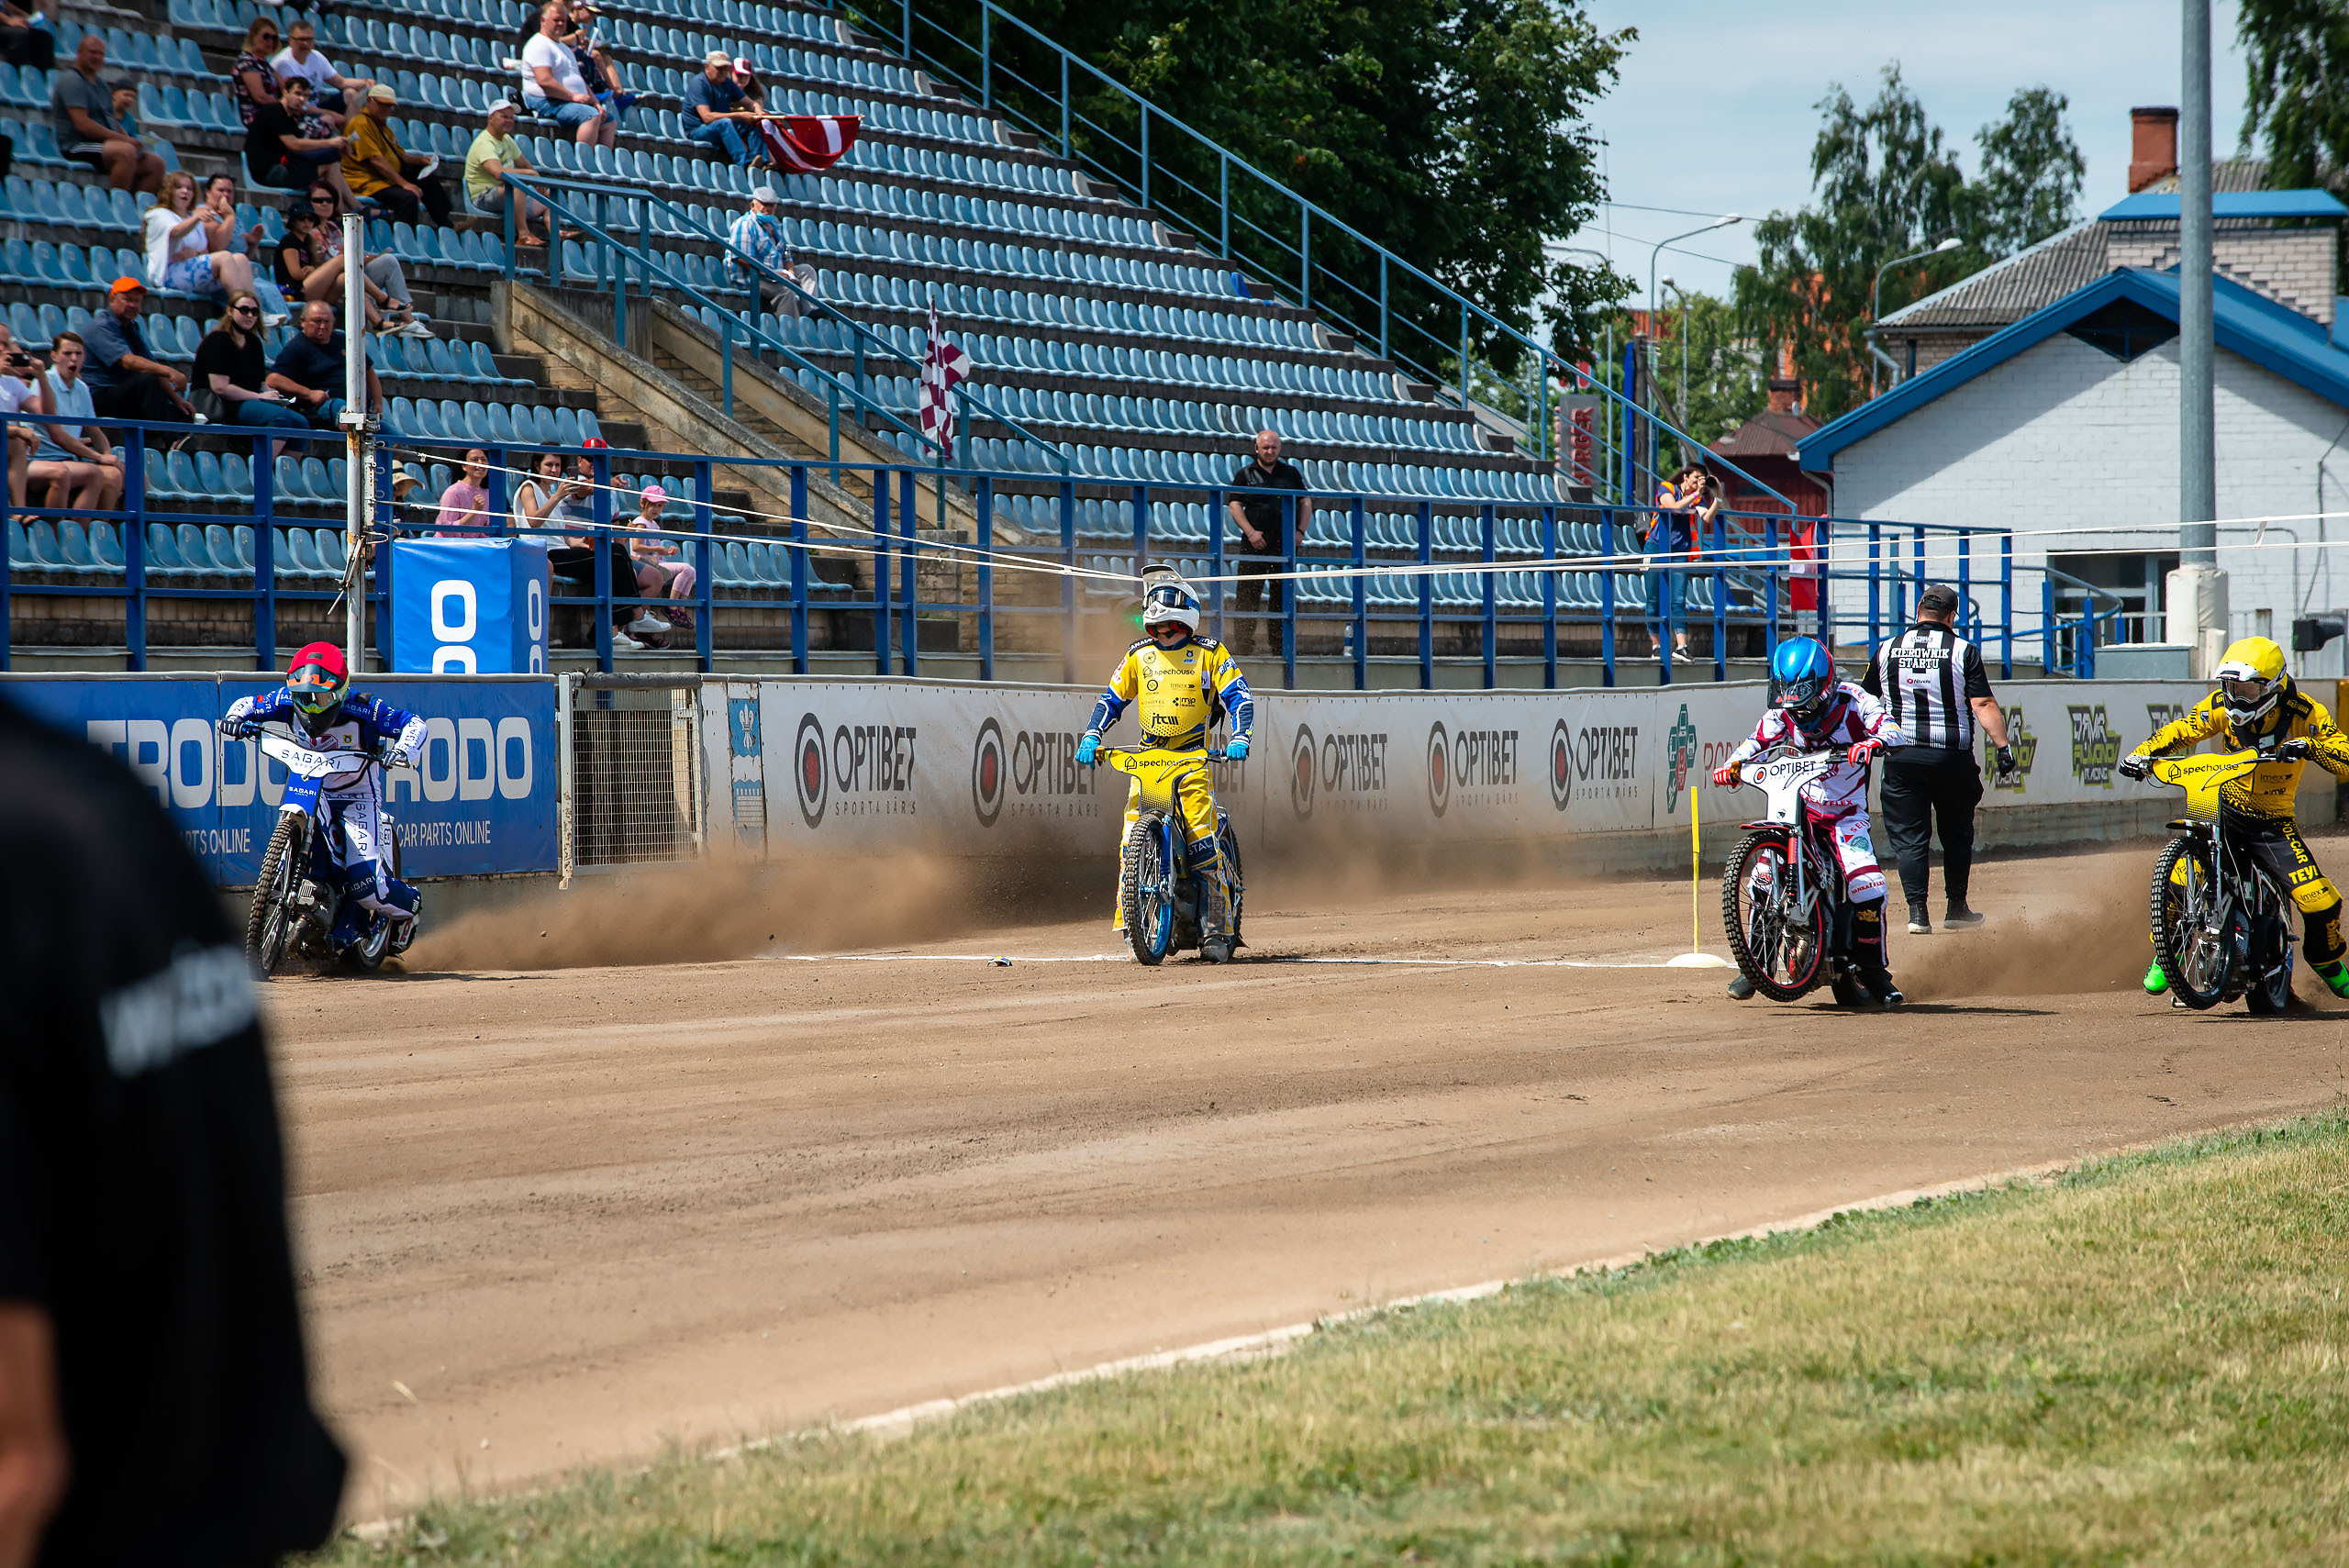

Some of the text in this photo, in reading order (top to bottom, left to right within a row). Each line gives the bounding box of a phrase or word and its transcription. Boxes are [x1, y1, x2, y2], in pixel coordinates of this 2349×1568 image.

[1890, 647, 1950, 659] KIEROWNIK
[1154, 668, 1196, 677] spechouse
[1898, 658, 1940, 669] STARTU
[281, 749, 340, 770] SAGARI
[833, 724, 917, 794] OPTIBET
[1321, 733, 1388, 793] OPTIBET
[1455, 730, 1519, 787] OPTIBET
[1576, 726, 1639, 782] OPTIBET
[1769, 761, 1815, 776] OPTIBET
[288, 786, 317, 797] SAGARI
[1575, 786, 1610, 800] SPORTA
[835, 799, 881, 817] SPORTA
[1011, 802, 1061, 817] SPORTA
[355, 803, 367, 858] SAGARI
[397, 823, 418, 847] CAR
[420, 821, 453, 846] PARTS
[454, 819, 492, 845] ONLINE
